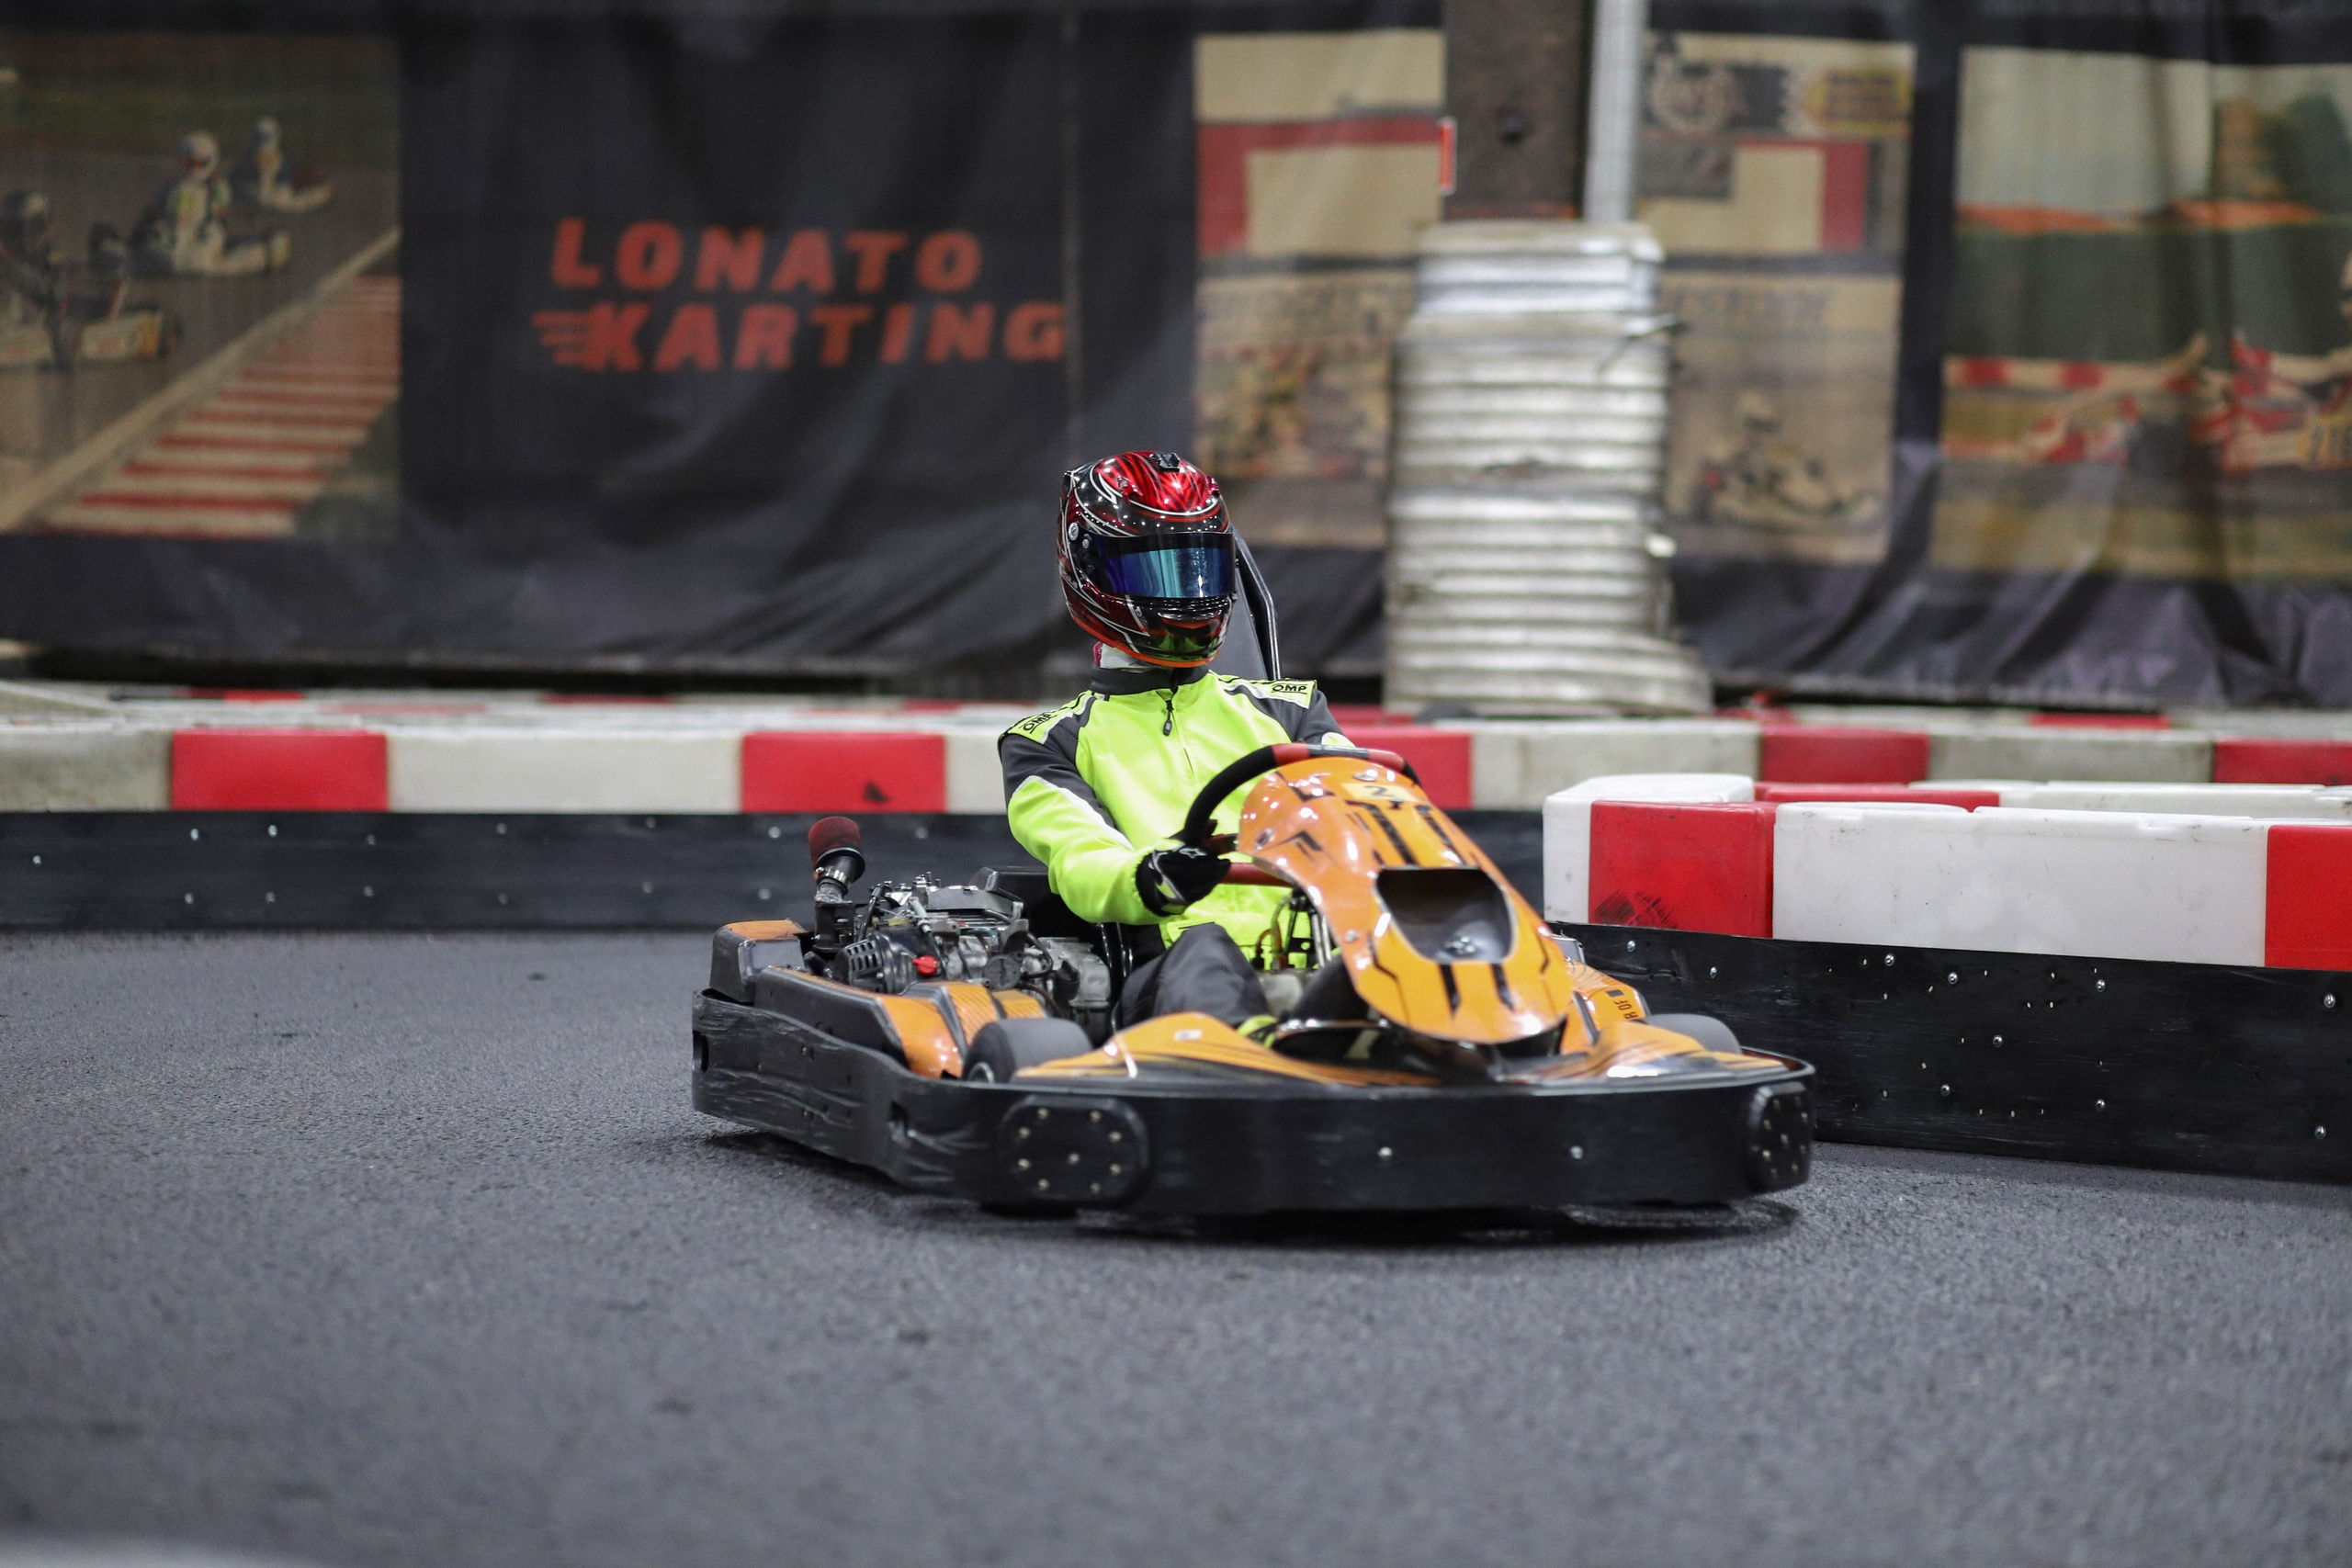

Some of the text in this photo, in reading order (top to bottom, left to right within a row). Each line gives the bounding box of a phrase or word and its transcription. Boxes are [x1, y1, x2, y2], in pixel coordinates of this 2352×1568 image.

[553, 218, 982, 292] LONATO
[579, 301, 1067, 372] KARTING
[1023, 714, 1051, 731] OMP
